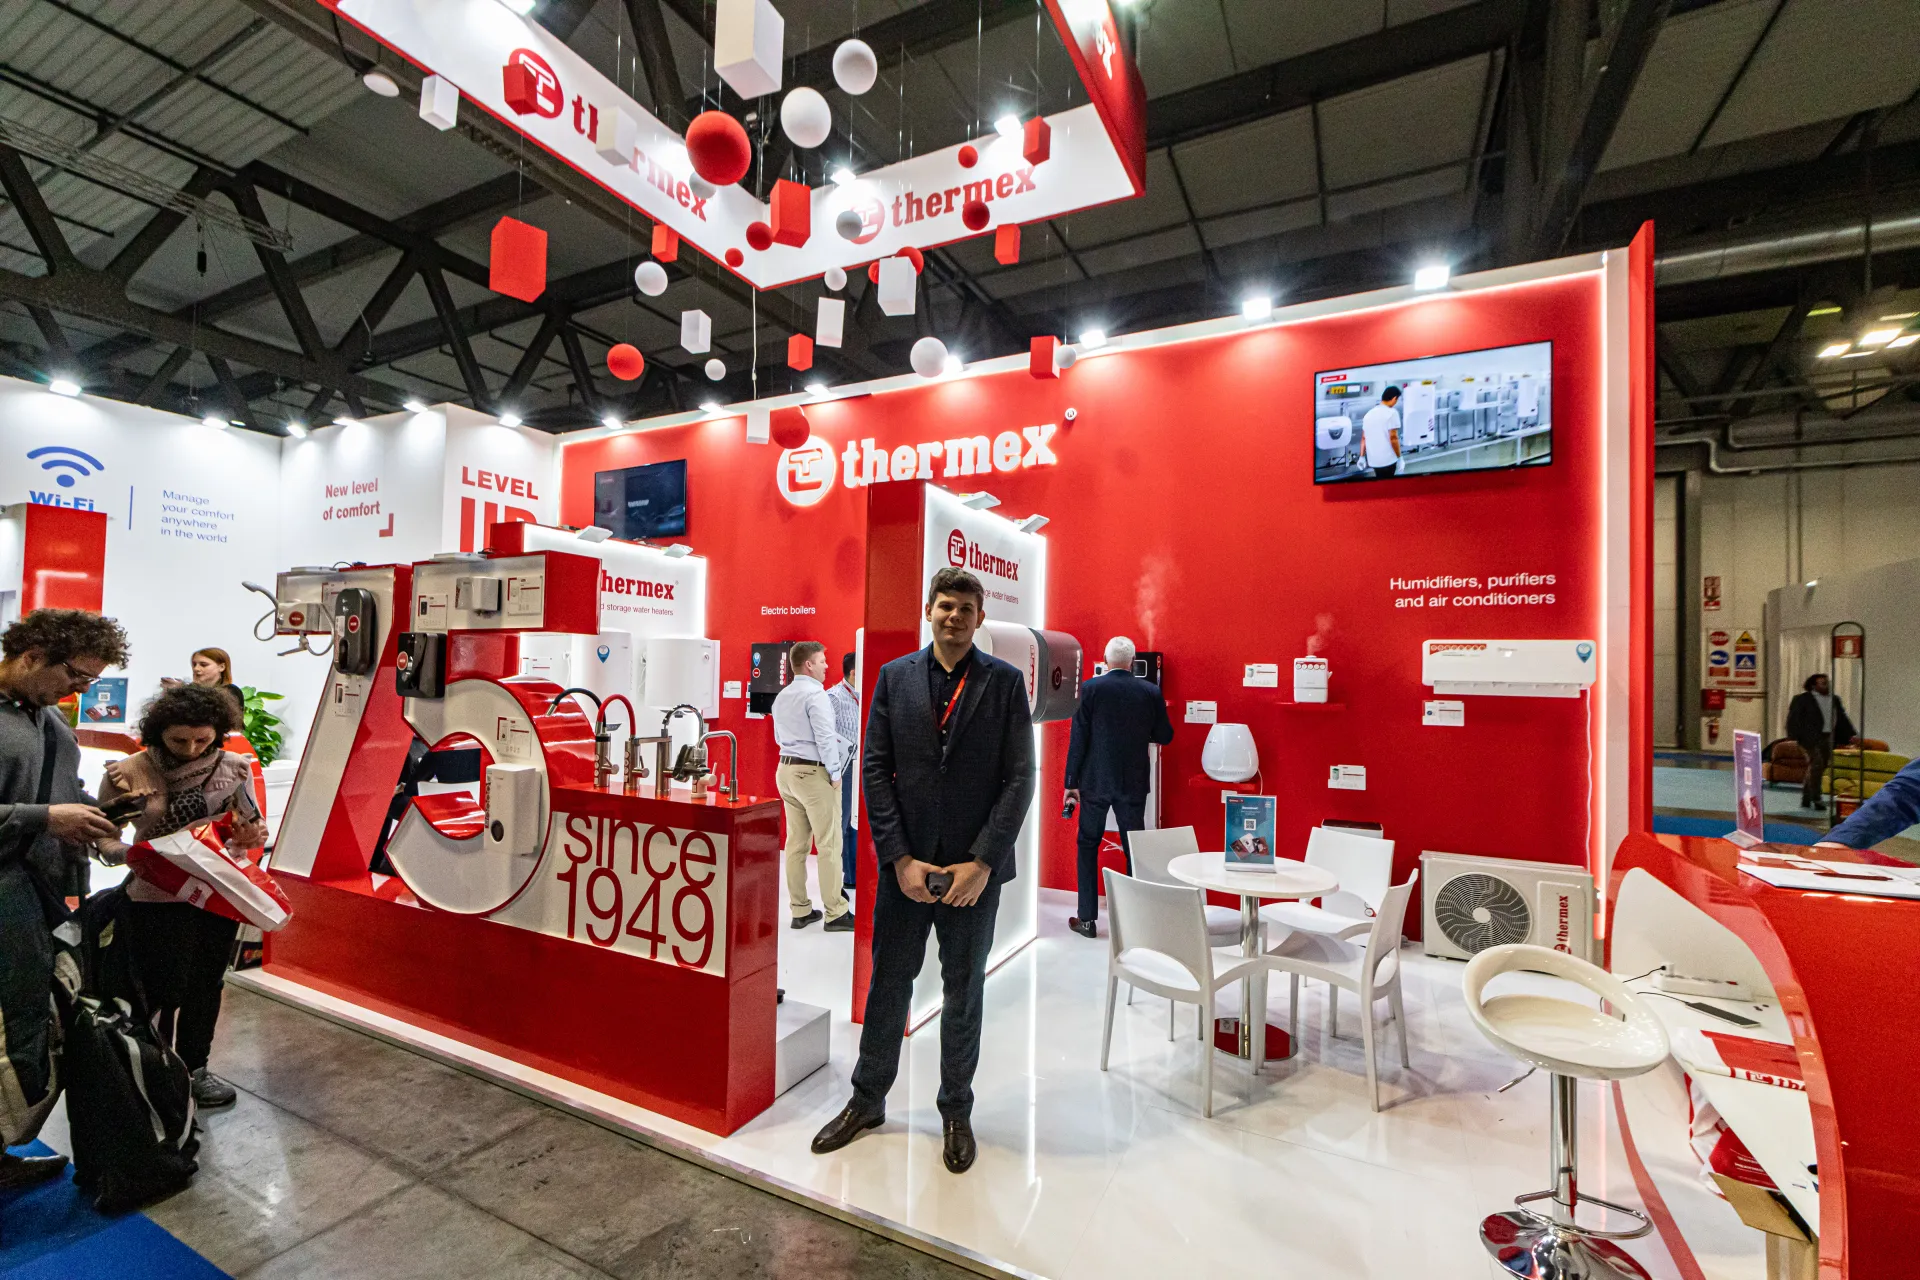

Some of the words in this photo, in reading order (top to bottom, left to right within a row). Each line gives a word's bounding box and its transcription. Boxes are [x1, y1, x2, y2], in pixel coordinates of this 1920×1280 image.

[892, 166, 1036, 227] thermex
[842, 424, 1057, 489] thermex
[325, 484, 348, 498] New
[352, 478, 379, 495] level
[461, 465, 539, 500] LEVEL
[29, 490, 94, 512] Wi-Fi
[162, 489, 210, 505] Manage
[161, 503, 187, 515] your
[191, 506, 235, 521] comfort
[322, 506, 334, 520] of
[336, 500, 381, 518] comfort
[161, 515, 218, 530] anywhere
[160, 527, 171, 536] in
[175, 527, 194, 539] the
[196, 532, 228, 543] world
[969, 541, 1019, 581] thermex
[600, 569, 675, 600] hermex
[1389, 575, 1483, 590] Humidifiers,
[1487, 572, 1556, 589] purifiers
[606, 603, 632, 614] storage
[633, 606, 650, 614] water
[651, 607, 674, 616] heaters
[1395, 595, 1424, 608] and
[1428, 594, 1448, 607] air
[1452, 592, 1556, 606] conditioners
[761, 605, 788, 616] Electric
[790, 605, 816, 615] boilers
[563, 811, 717, 888] since
[556, 861, 715, 970] 1949
[1556, 895, 1569, 942] thermex
